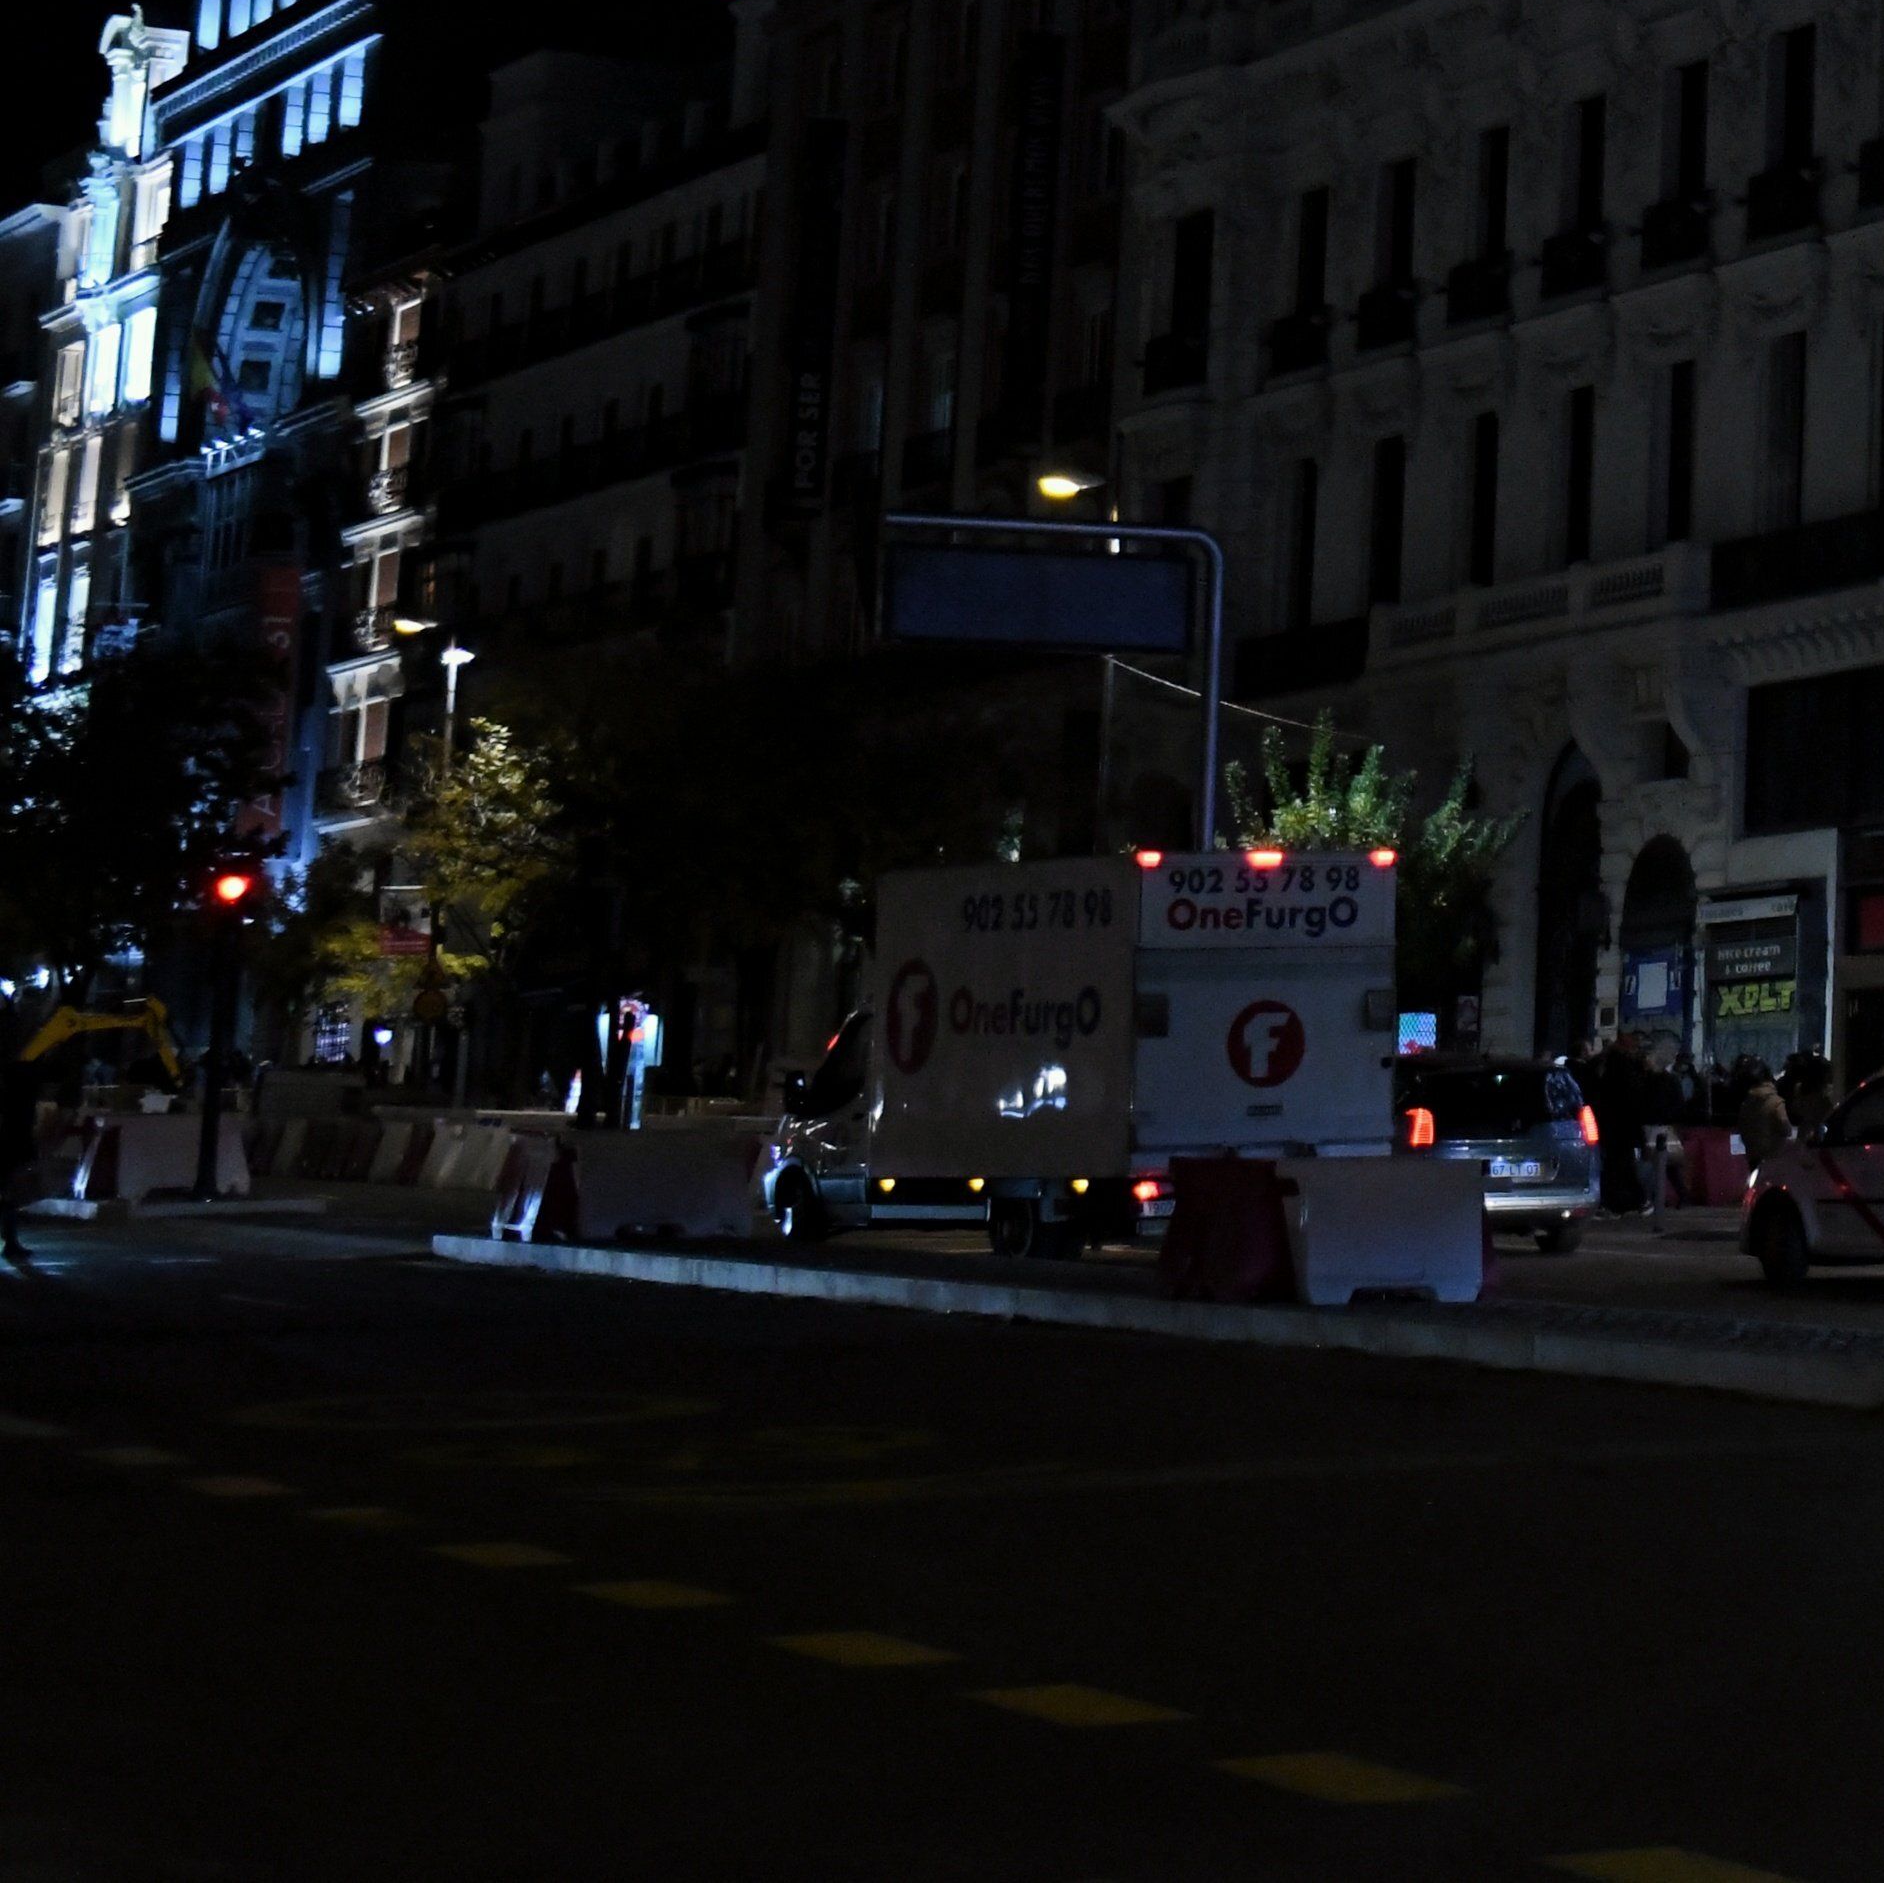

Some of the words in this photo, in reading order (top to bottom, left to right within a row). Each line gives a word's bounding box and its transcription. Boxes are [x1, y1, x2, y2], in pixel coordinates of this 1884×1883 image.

[1168, 868, 1224, 894] 902
[1234, 868, 1270, 894] 55
[1280, 867, 1315, 893] 78
[1325, 866, 1361, 892] 98
[962, 893, 1003, 933] 902
[1011, 892, 1040, 931] 55
[1046, 891, 1076, 930] 78
[1083, 888, 1112, 928] 98
[1167, 896, 1360, 938] OneFurgO
[949, 985, 1102, 1050] OneFurgO
